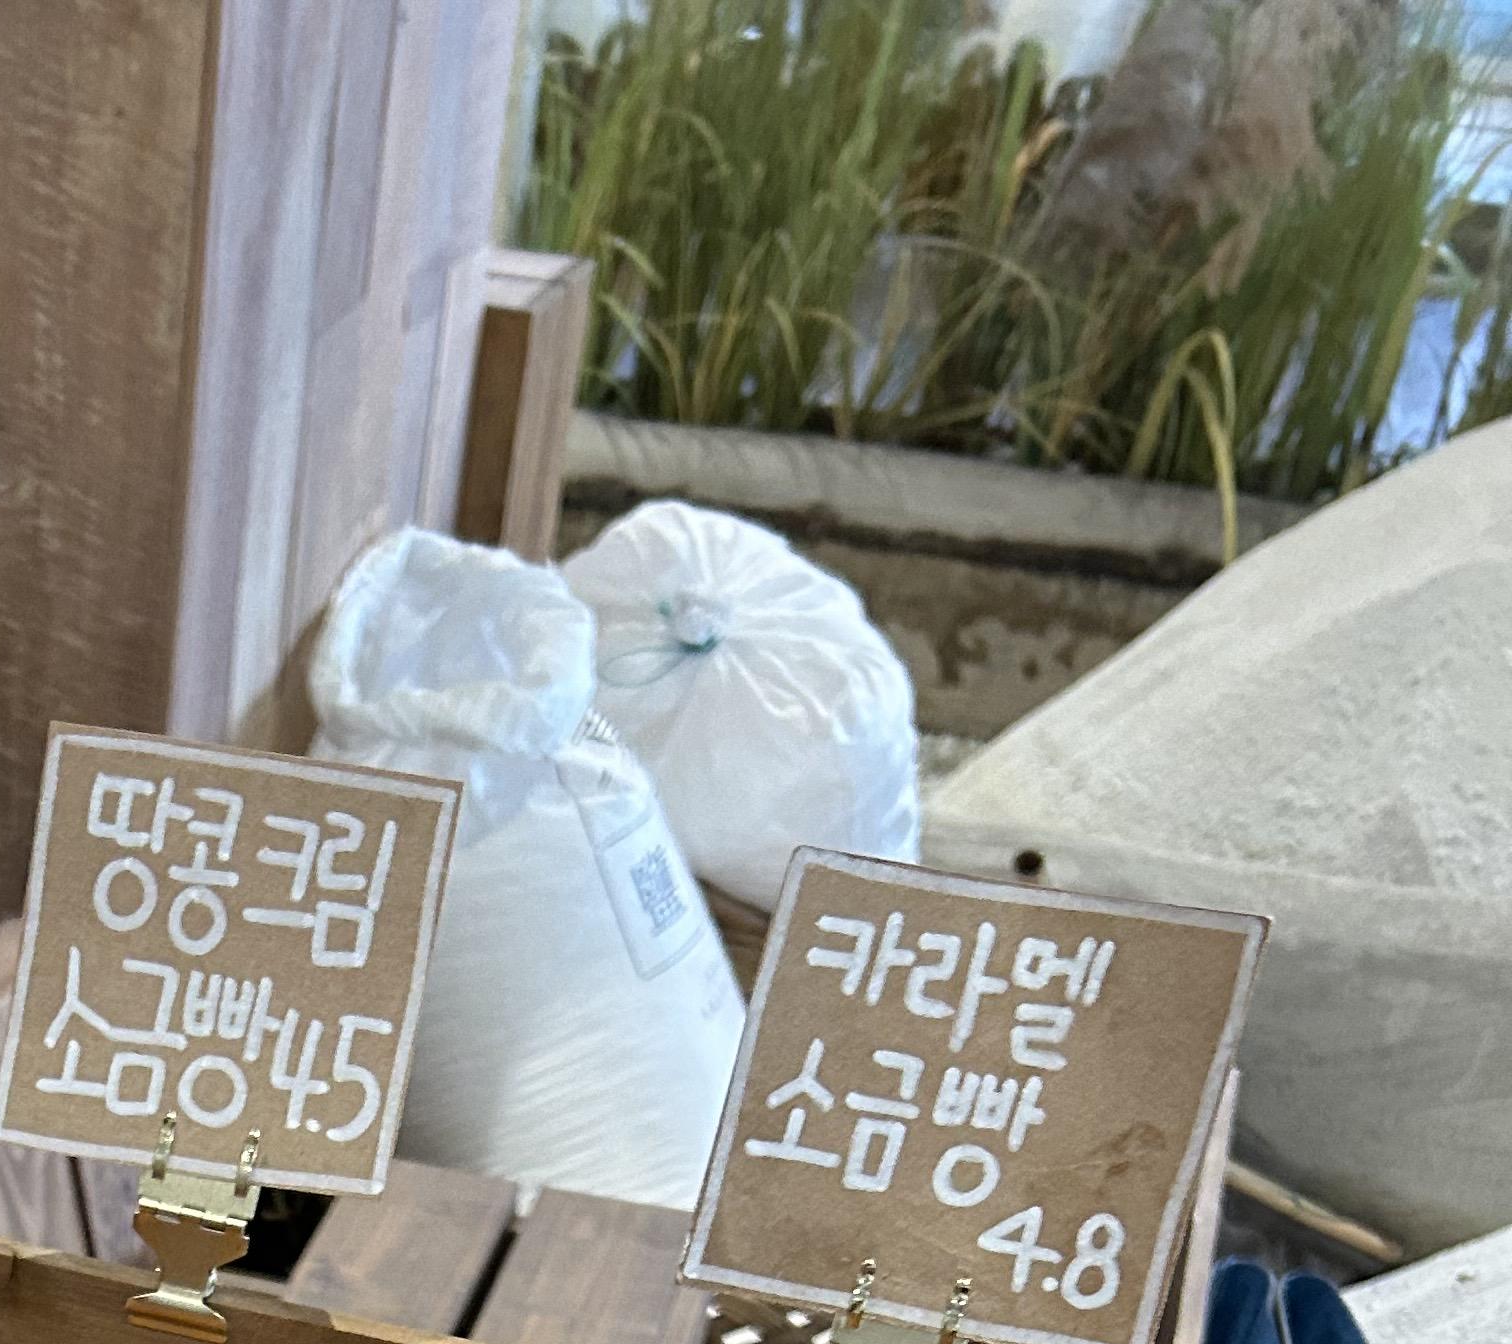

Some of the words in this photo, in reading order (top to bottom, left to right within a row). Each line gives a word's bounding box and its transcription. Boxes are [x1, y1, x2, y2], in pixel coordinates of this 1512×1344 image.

[806, 911, 1116, 1070] 카라멜
[744, 1037, 1046, 1208] 소금빵
[977, 1205, 1126, 1310] 4.8
